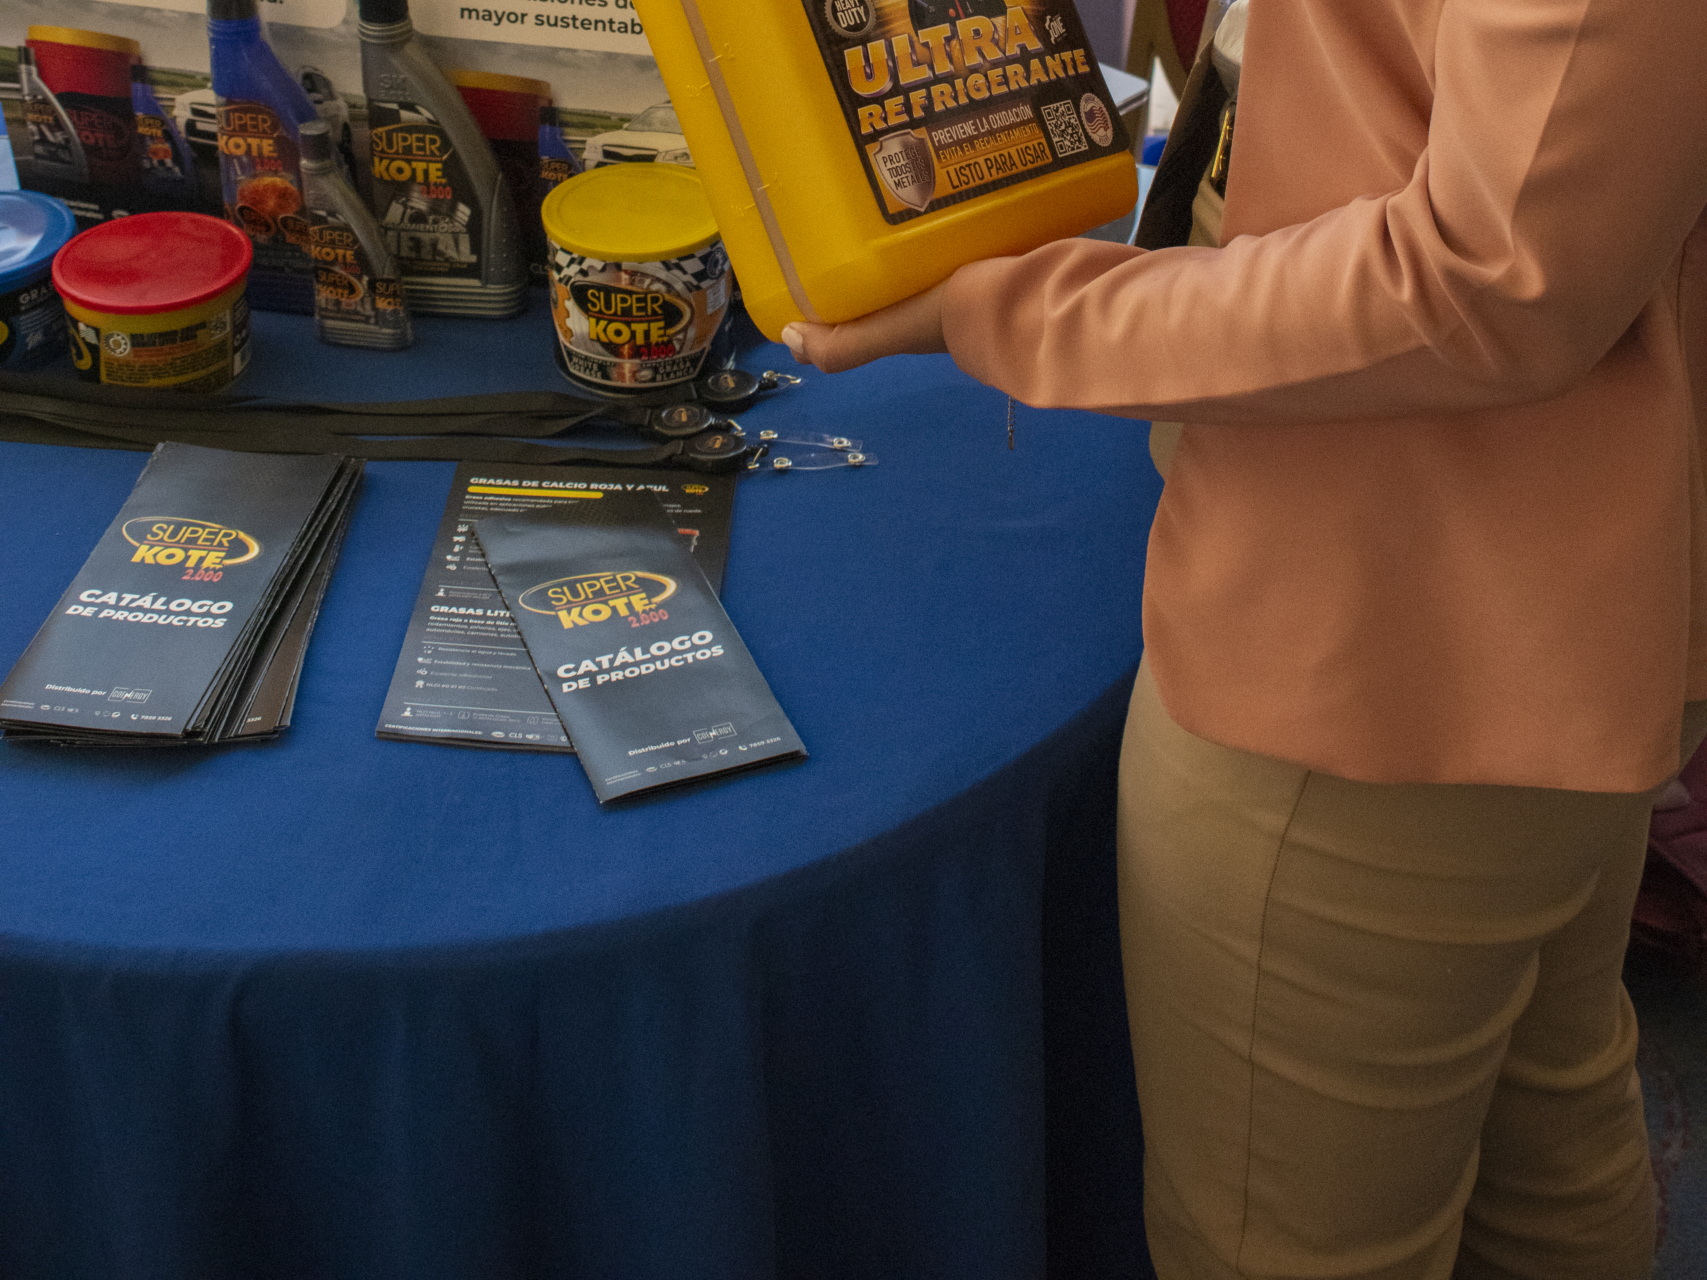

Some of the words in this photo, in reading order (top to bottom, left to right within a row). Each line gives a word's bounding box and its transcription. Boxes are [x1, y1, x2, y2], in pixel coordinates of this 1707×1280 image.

[459, 5, 528, 27] mayor
[534, 11, 645, 36] sustentab
[836, 5, 867, 29] DUTY
[844, 6, 1045, 98] ULTRA
[857, 49, 1091, 135] REFRIGERANTE
[931, 121, 978, 147] PREVIENE
[976, 117, 991, 133] LA
[988, 103, 1034, 129] OXIDACIÓN
[372, 130, 441, 156] SUPER
[939, 144, 963, 162] EVITA
[963, 142, 975, 155] EL
[974, 123, 1039, 151] RECALENTAMIENTO
[882, 145, 921, 168] PROTEGE
[946, 161, 985, 190] LISTO
[984, 151, 1018, 178] PARA
[1016, 141, 1050, 167] USAR
[372, 157, 448, 183] KOTE
[887, 162, 912, 179] TODOS
[893, 170, 930, 190] METALES
[310, 231, 354, 247] SUPER
[310, 245, 357, 263] KOTE
[587, 289, 664, 316] SUPER
[588, 317, 669, 346] KOTE
[640, 344, 675, 360] 2.000
[656, 367, 695, 382] BLANCA
[659, 361, 691, 374] GRASA
[469, 477, 519, 487] GRASAS
[521, 480, 539, 488] DE
[541, 481, 588, 490] CALCIO
[590, 483, 622, 491] ROJA
[147, 523, 238, 547] SUPER
[130, 545, 227, 570] KOTE
[181, 569, 224, 583] 2.000
[547, 573, 641, 606] SUPER
[79, 589, 234, 615] CATÁLOGO
[430, 605, 484, 616] GRASAS
[556, 592, 657, 630] KOTE
[65, 605, 99, 617] DE
[98, 609, 228, 628] PRODUCTOS
[627, 609, 669, 628] 2.000
[556, 630, 713, 679] CATÁLOGO
[562, 677, 591, 693] DE
[596, 645, 724, 685] PRODUCTOS
[45, 684, 90, 695] Distribuido
[628, 740, 676, 756] Distribuido
[676, 737, 691, 746] por
